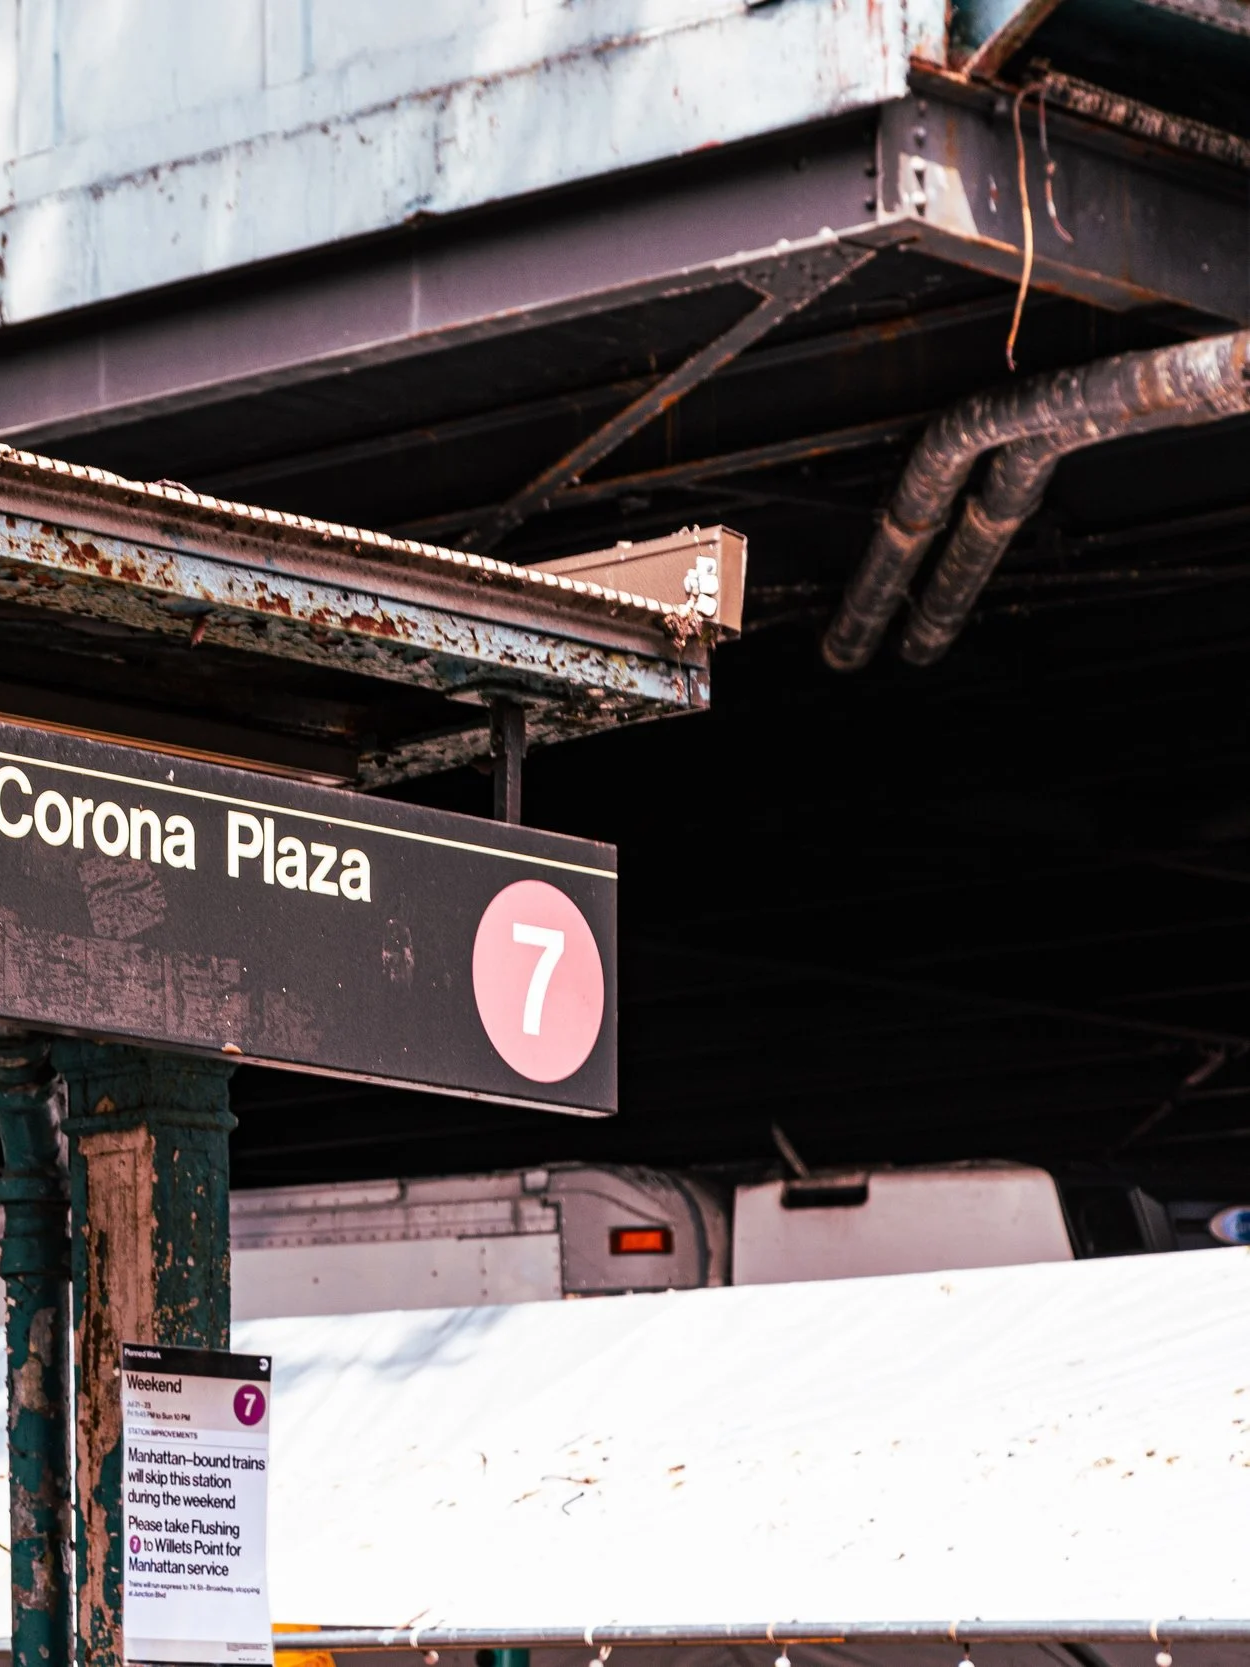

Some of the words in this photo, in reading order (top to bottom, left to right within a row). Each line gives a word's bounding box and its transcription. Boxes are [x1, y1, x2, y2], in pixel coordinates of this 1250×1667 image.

[228, 811, 372, 903] Plaza
[512, 923, 566, 1037] 7
[124, 1347, 146, 1358] Planned
[146, 1350, 161, 1359] Work
[126, 1373, 182, 1394] Weekend
[243, 1393, 257, 1417] 7
[162, 1412, 173, 1420] Sun
[128, 1427, 150, 1436] STATION
[150, 1430, 198, 1439] IMPROVEMENTS
[128, 1447, 230, 1469] Manhattan-bound
[232, 1455, 266, 1471] trains
[128, 1468, 144, 1483] will
[145, 1470, 168, 1487] skip
[170, 1471, 191, 1486] this
[192, 1473, 231, 1488] station
[128, 1488, 161, 1508] during
[162, 1491, 181, 1506] the
[183, 1494, 236, 1509] weekend
[128, 1515, 162, 1532] Please
[165, 1518, 189, 1534] take
[191, 1519, 240, 1539] Flushing
[143, 1540, 153, 1552] to
[155, 1538, 192, 1554] Willets
[194, 1540, 224, 1556] Point
[226, 1542, 241, 1557] for
[128, 1556, 185, 1574] Manhattan
[187, 1561, 229, 1577] service
[160, 1583, 182, 1591] express
